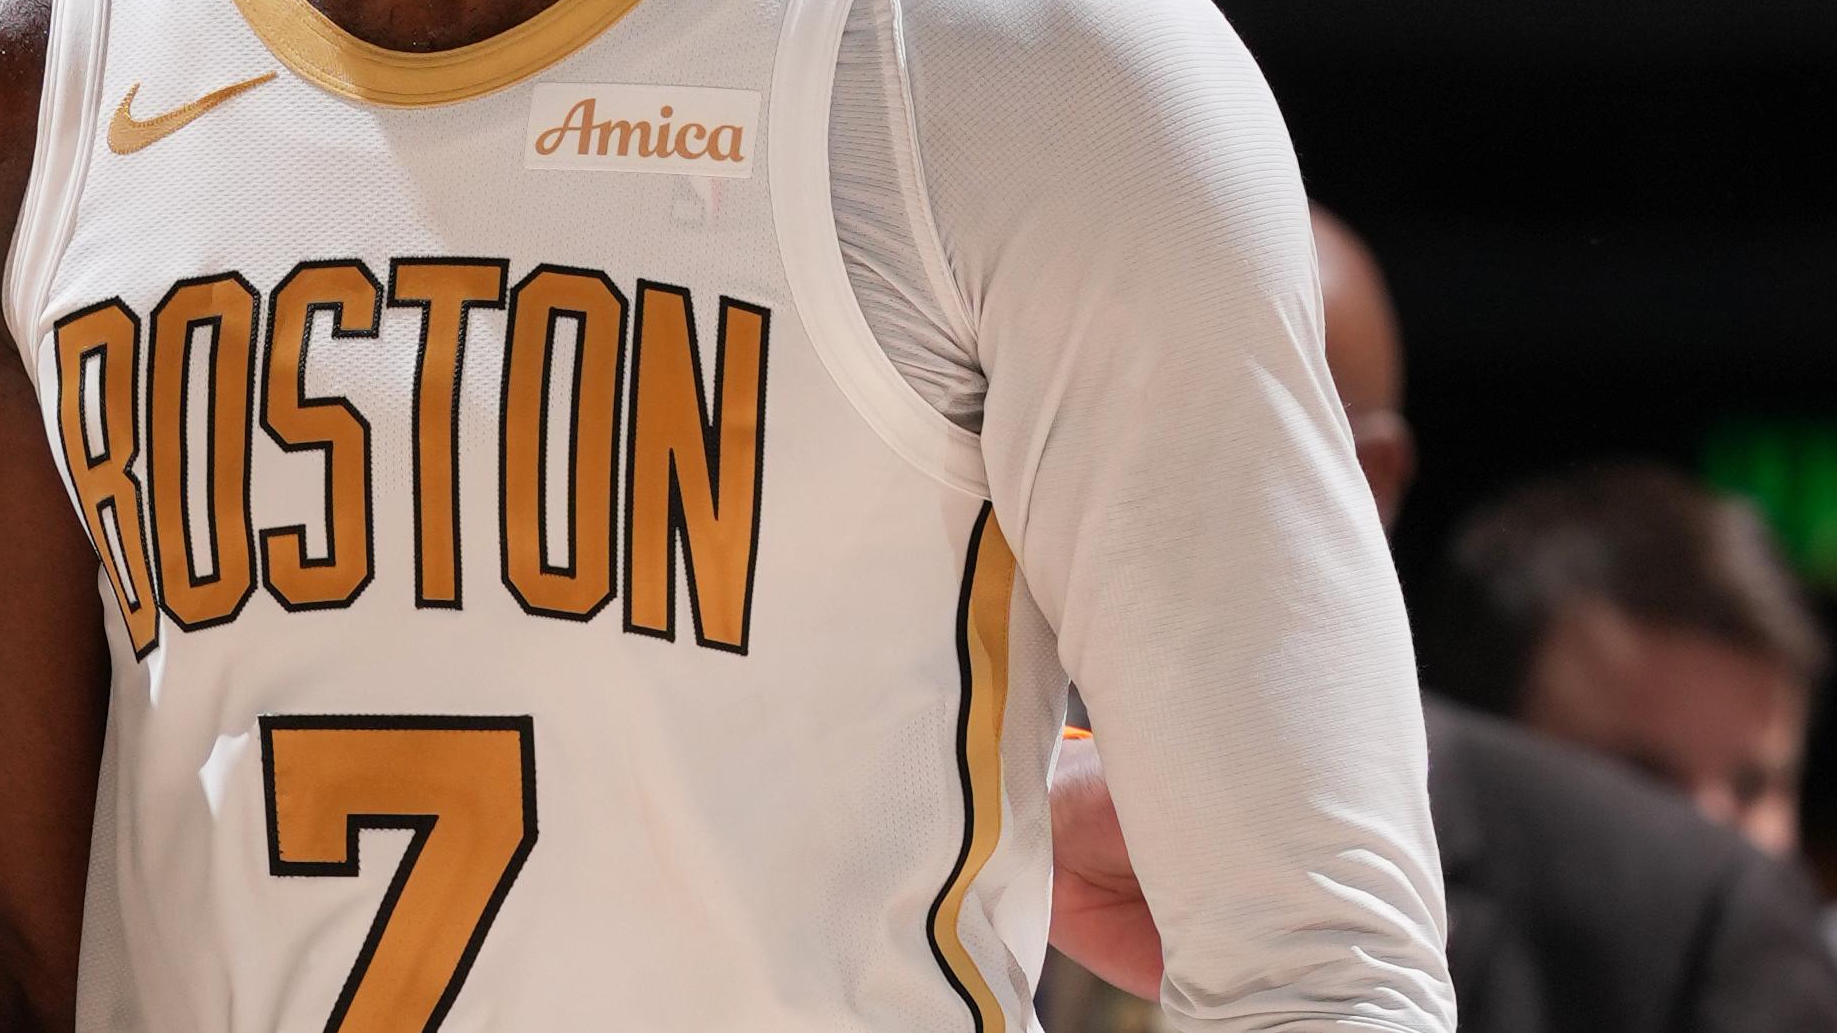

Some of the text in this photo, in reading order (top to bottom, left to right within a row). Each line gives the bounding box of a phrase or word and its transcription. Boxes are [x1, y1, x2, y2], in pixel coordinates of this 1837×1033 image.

[535, 98, 745, 162] Amica
[53, 256, 771, 663] BOSTON
[259, 715, 538, 1033] 7
